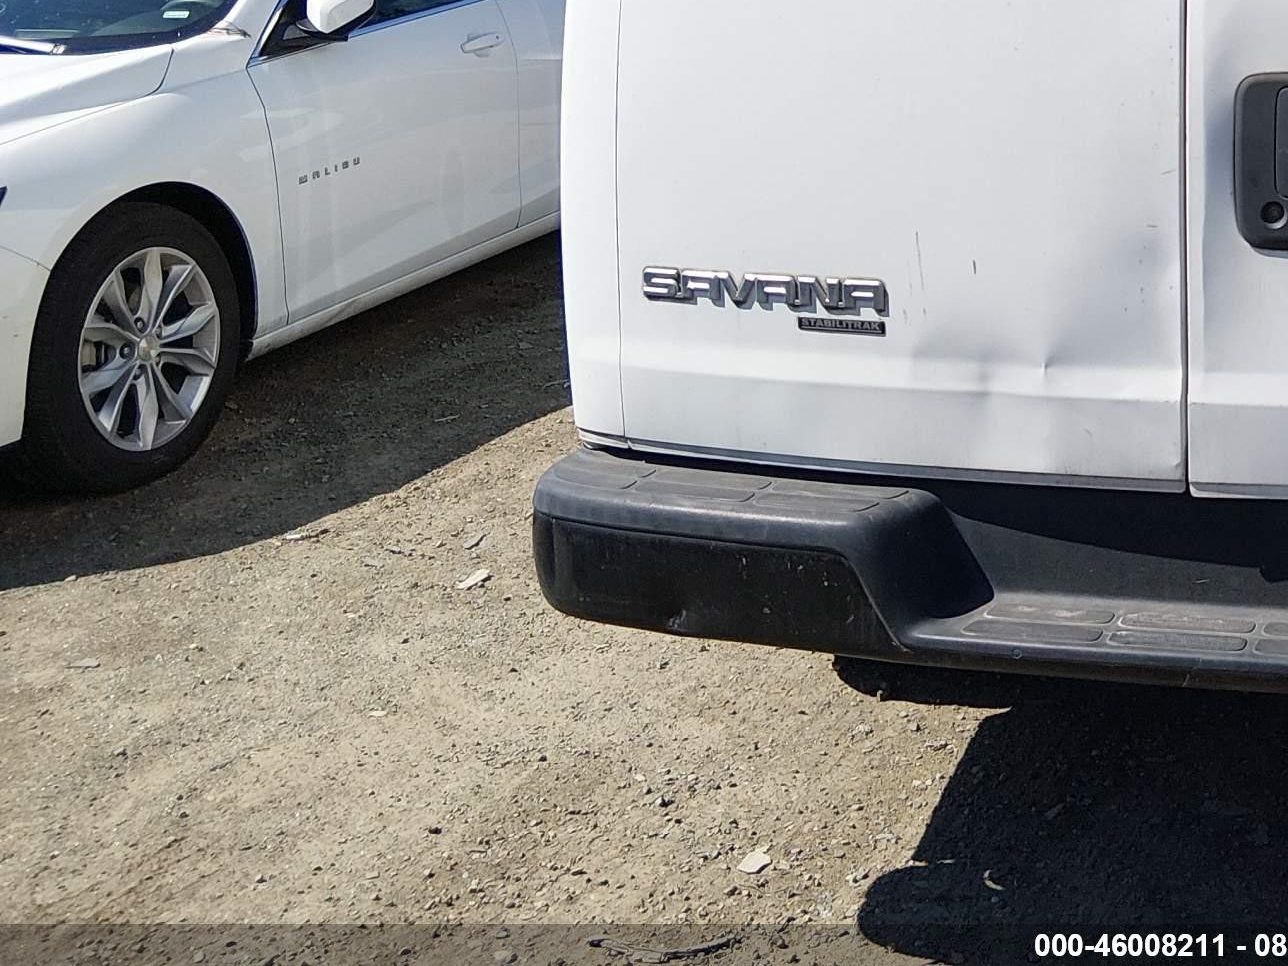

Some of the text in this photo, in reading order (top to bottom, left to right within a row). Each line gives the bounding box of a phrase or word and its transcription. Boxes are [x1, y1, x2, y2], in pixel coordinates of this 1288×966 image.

[298, 156, 361, 185] MALIBU
[642, 266, 887, 311] SAVANA
[801, 317, 881, 332] STABILITRAK
